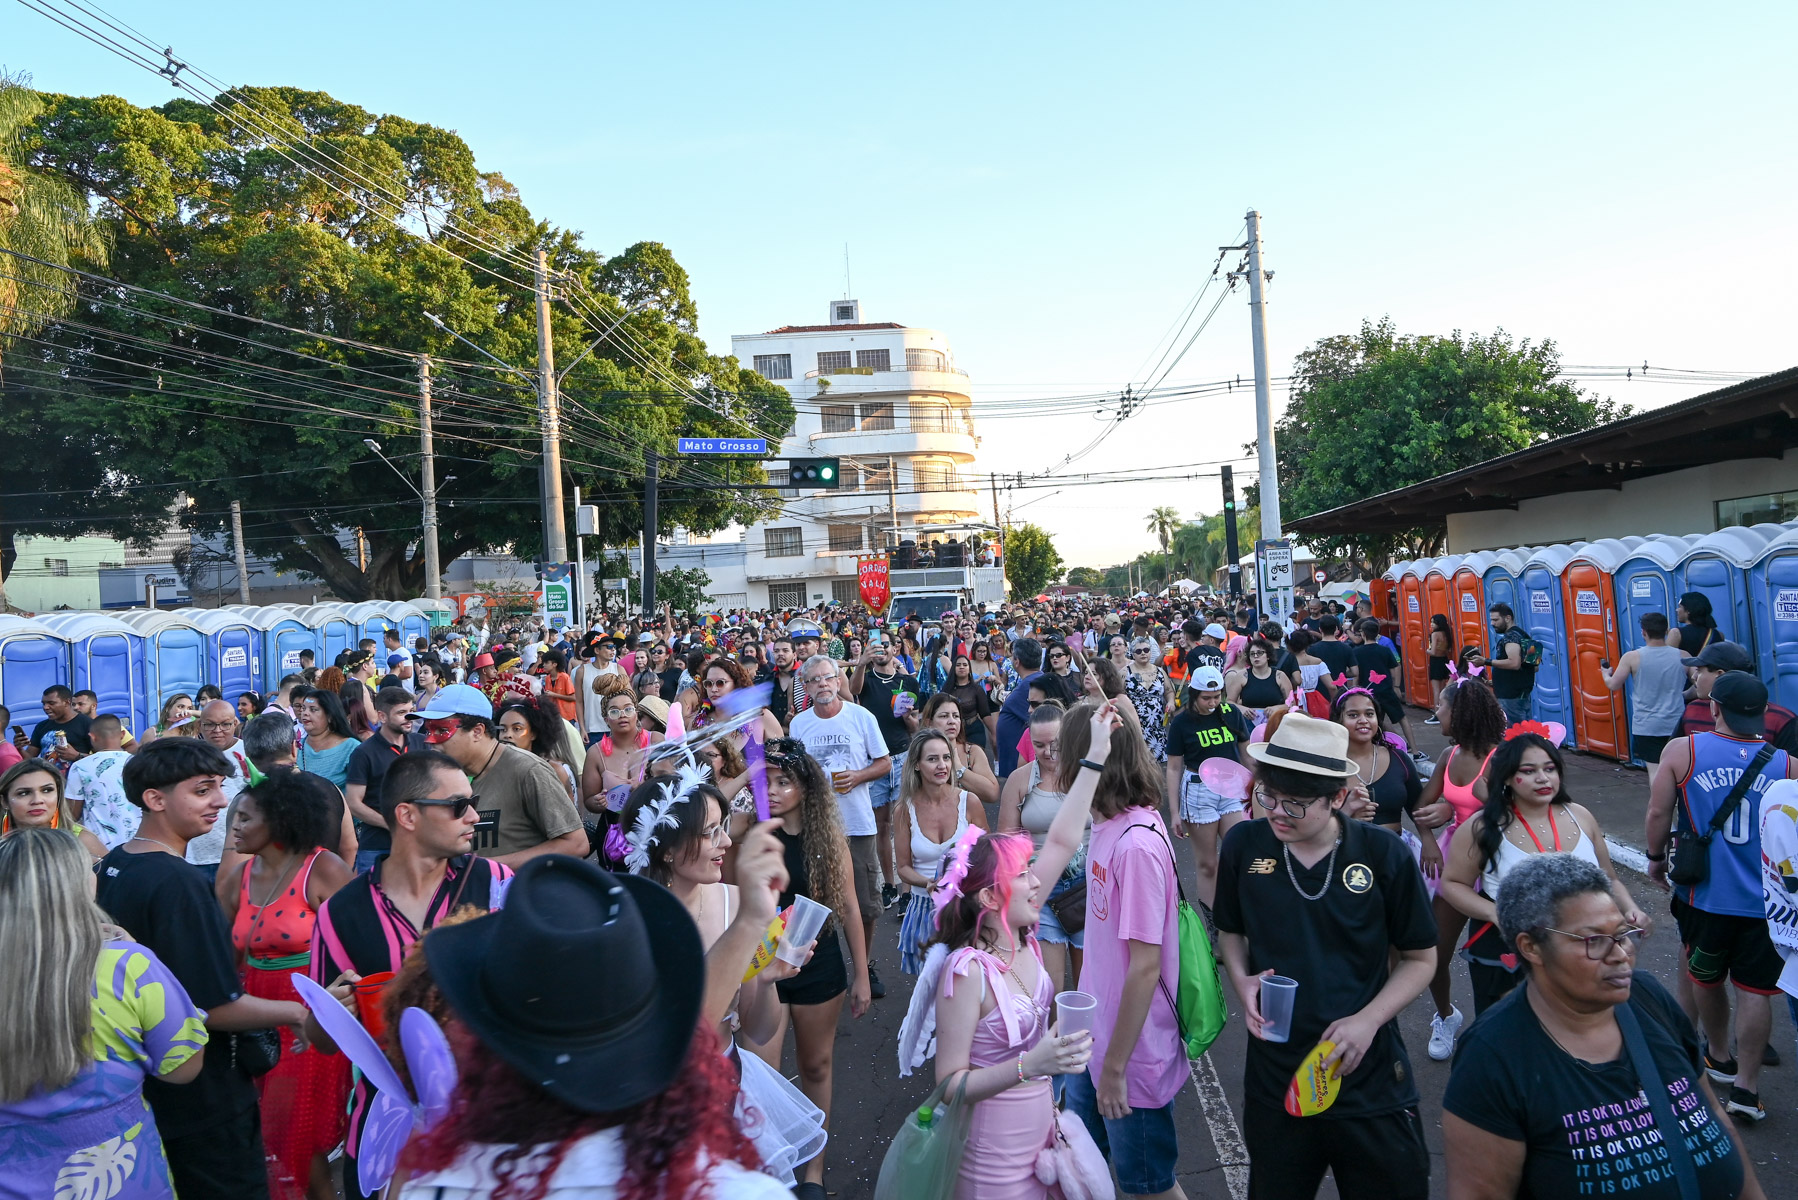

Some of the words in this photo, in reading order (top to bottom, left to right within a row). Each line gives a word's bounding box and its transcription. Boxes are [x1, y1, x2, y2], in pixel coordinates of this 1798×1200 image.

[685, 441, 713, 450] Mato
[720, 441, 759, 450] Grosso
[861, 580, 885, 589] VALU
[809, 734, 851, 745] TROPICS
[1196, 726, 1235, 748] USA
[1723, 797, 1751, 845] 0
[1667, 836, 1679, 874] FILA
[1776, 925, 1798, 941] VIB
[1563, 1114, 1574, 1127] IT
[1577, 1110, 1590, 1124] IS
[1593, 1106, 1608, 1121] OK
[1609, 1103, 1623, 1117] TO
[1625, 1098, 1643, 1113] LOV
[1668, 1077, 1689, 1096] SELF
[1568, 1131, 1580, 1145] IT
[1585, 1128, 1597, 1141] IS
[1601, 1123, 1616, 1138] OK
[1618, 1119, 1632, 1133] TO
[1635, 1112, 1654, 1129] LOV
[1679, 1093, 1698, 1112] SELF
[1572, 1149, 1584, 1160] IT
[1590, 1145, 1603, 1158] IS
[1607, 1141, 1625, 1155] OK
[1626, 1136, 1642, 1150] TO
[1645, 1129, 1663, 1145] LOV
[1690, 1106, 1708, 1128] SELF
[1577, 1165, 1590, 1177] IT
[1596, 1162, 1610, 1176] IS
[1616, 1158, 1634, 1172] OK
[1636, 1152, 1651, 1167] TO
[1654, 1147, 1668, 1161] LO
[1684, 1134, 1700, 1150] MY
[1702, 1121, 1720, 1143] SELF
[1580, 1182, 1593, 1194] IT
[1601, 1180, 1615, 1194] IS
[1622, 1175, 1641, 1190] OK
[1644, 1169, 1660, 1184] TO
[1663, 1163, 1674, 1178] LO
[1693, 1150, 1712, 1167] MY
[1716, 1136, 1732, 1158] SELF
